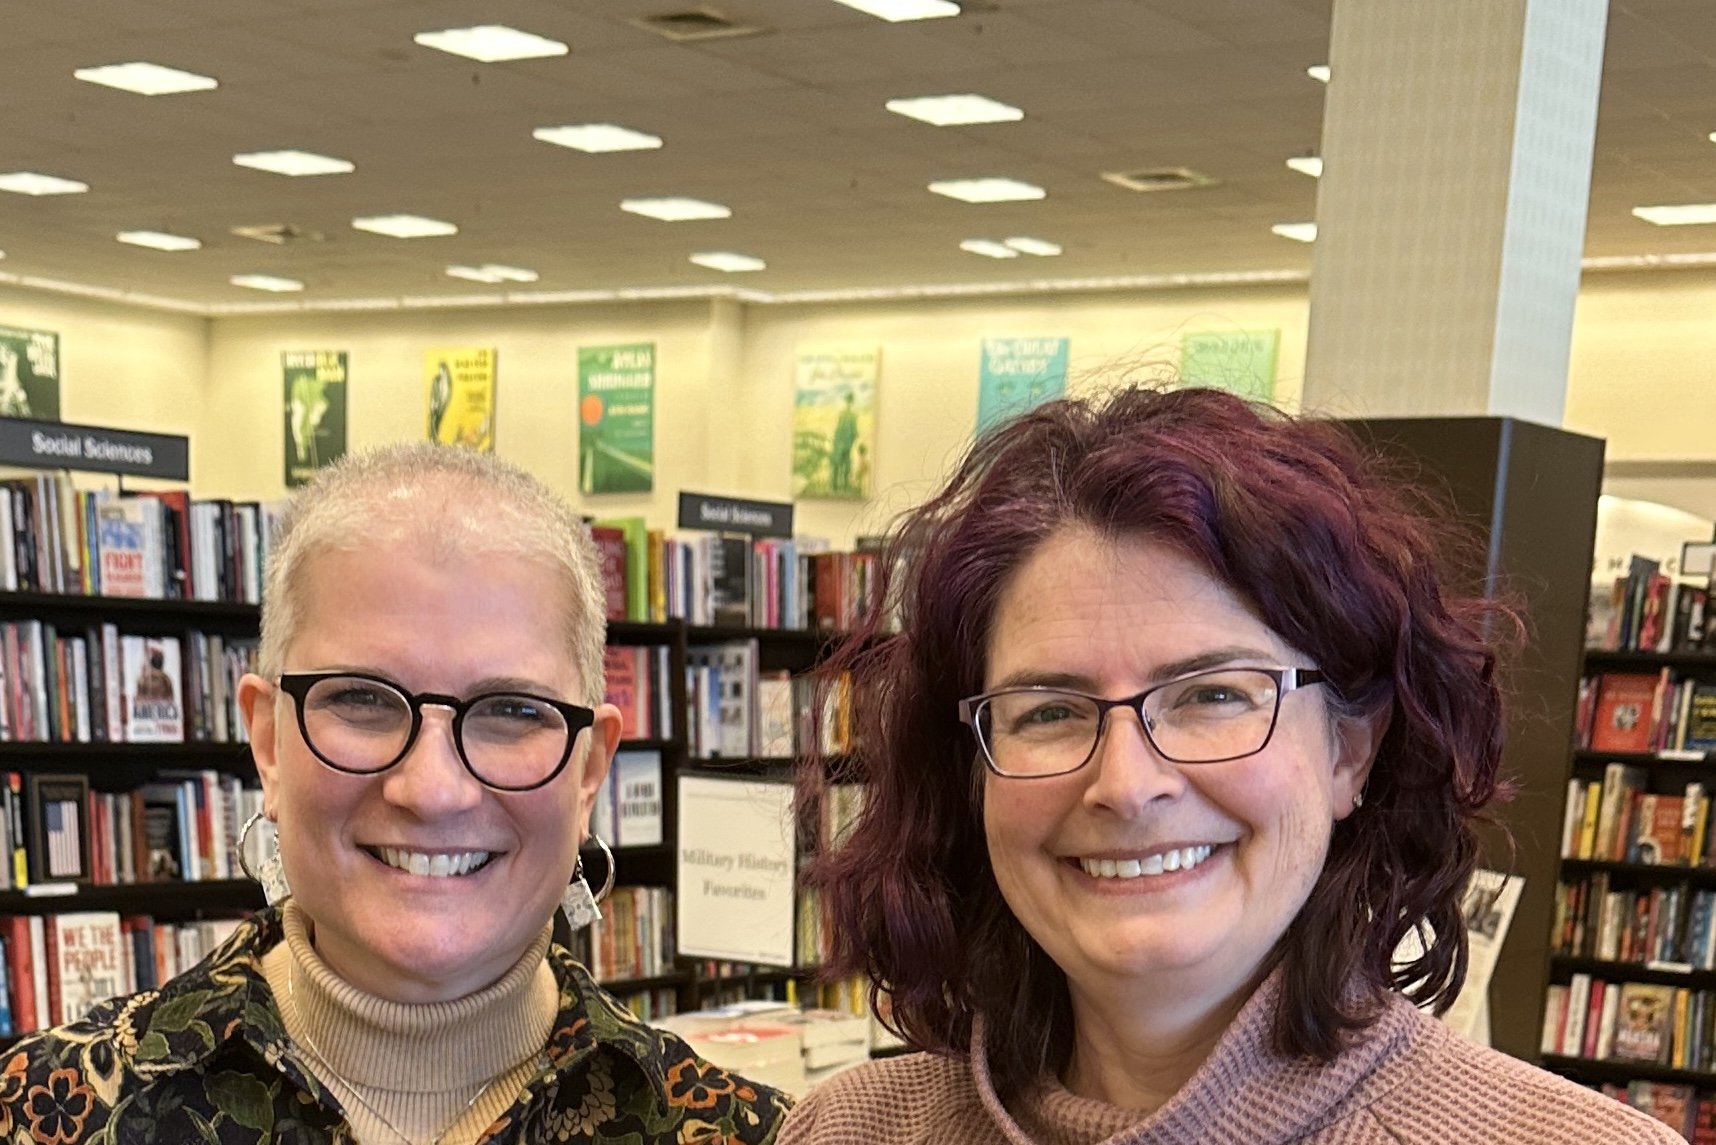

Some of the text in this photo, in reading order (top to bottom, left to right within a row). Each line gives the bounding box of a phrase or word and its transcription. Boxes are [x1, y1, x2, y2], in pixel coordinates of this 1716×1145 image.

[31, 430, 153, 465] Social Sciences
[700, 501, 773, 528] Social Sciences
[683, 849, 789, 876] Military History
[703, 879, 767, 900] Favorites
[63, 924, 115, 947] WE THE
[63, 947, 117, 972] PEOPLE
